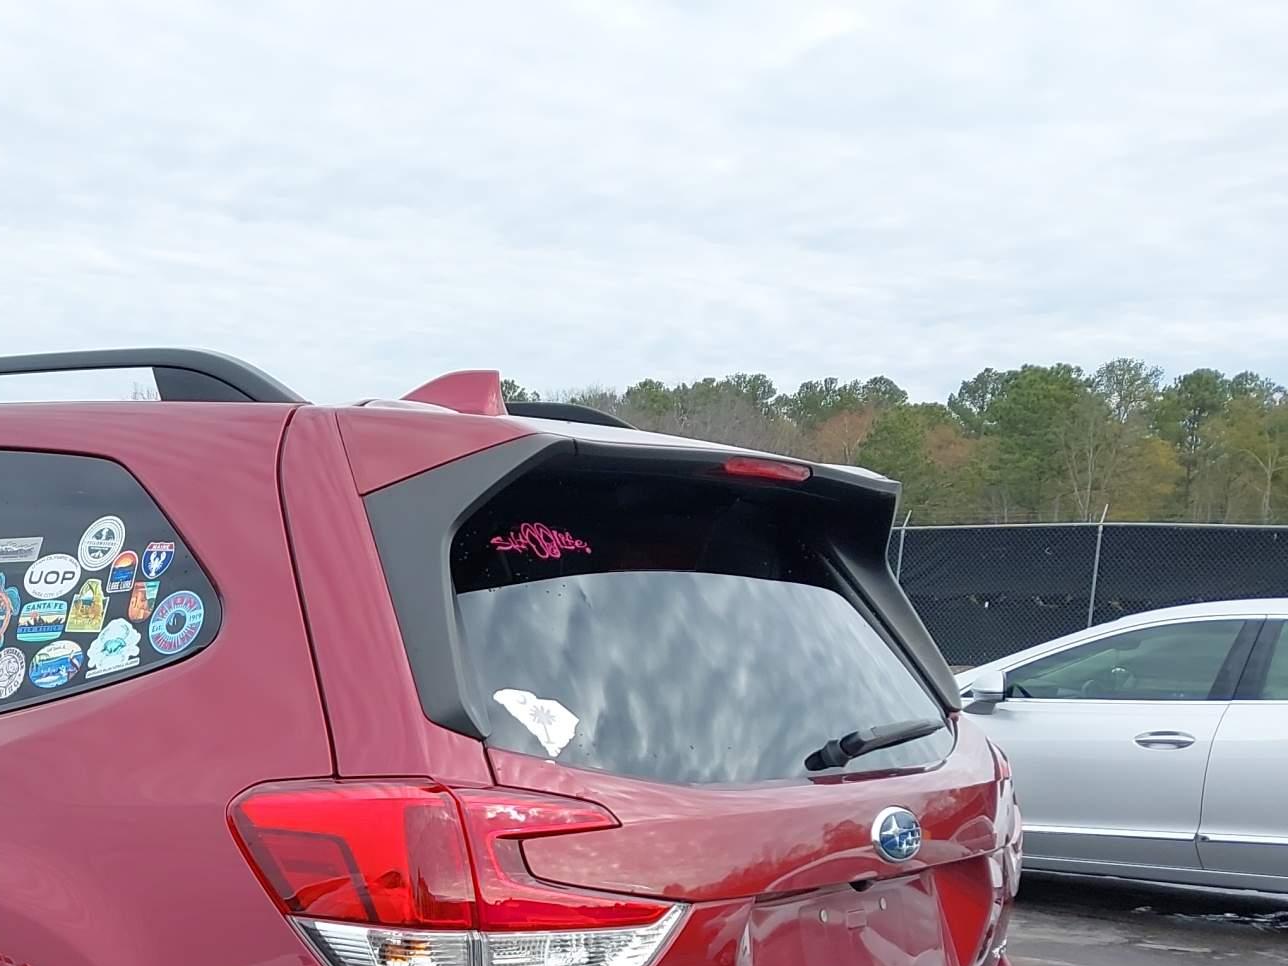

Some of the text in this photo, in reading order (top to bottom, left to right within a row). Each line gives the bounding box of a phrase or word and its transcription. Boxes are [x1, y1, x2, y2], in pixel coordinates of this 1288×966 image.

[28, 570, 76, 584] UOP
[25, 602, 64, 611] SANTA FE
